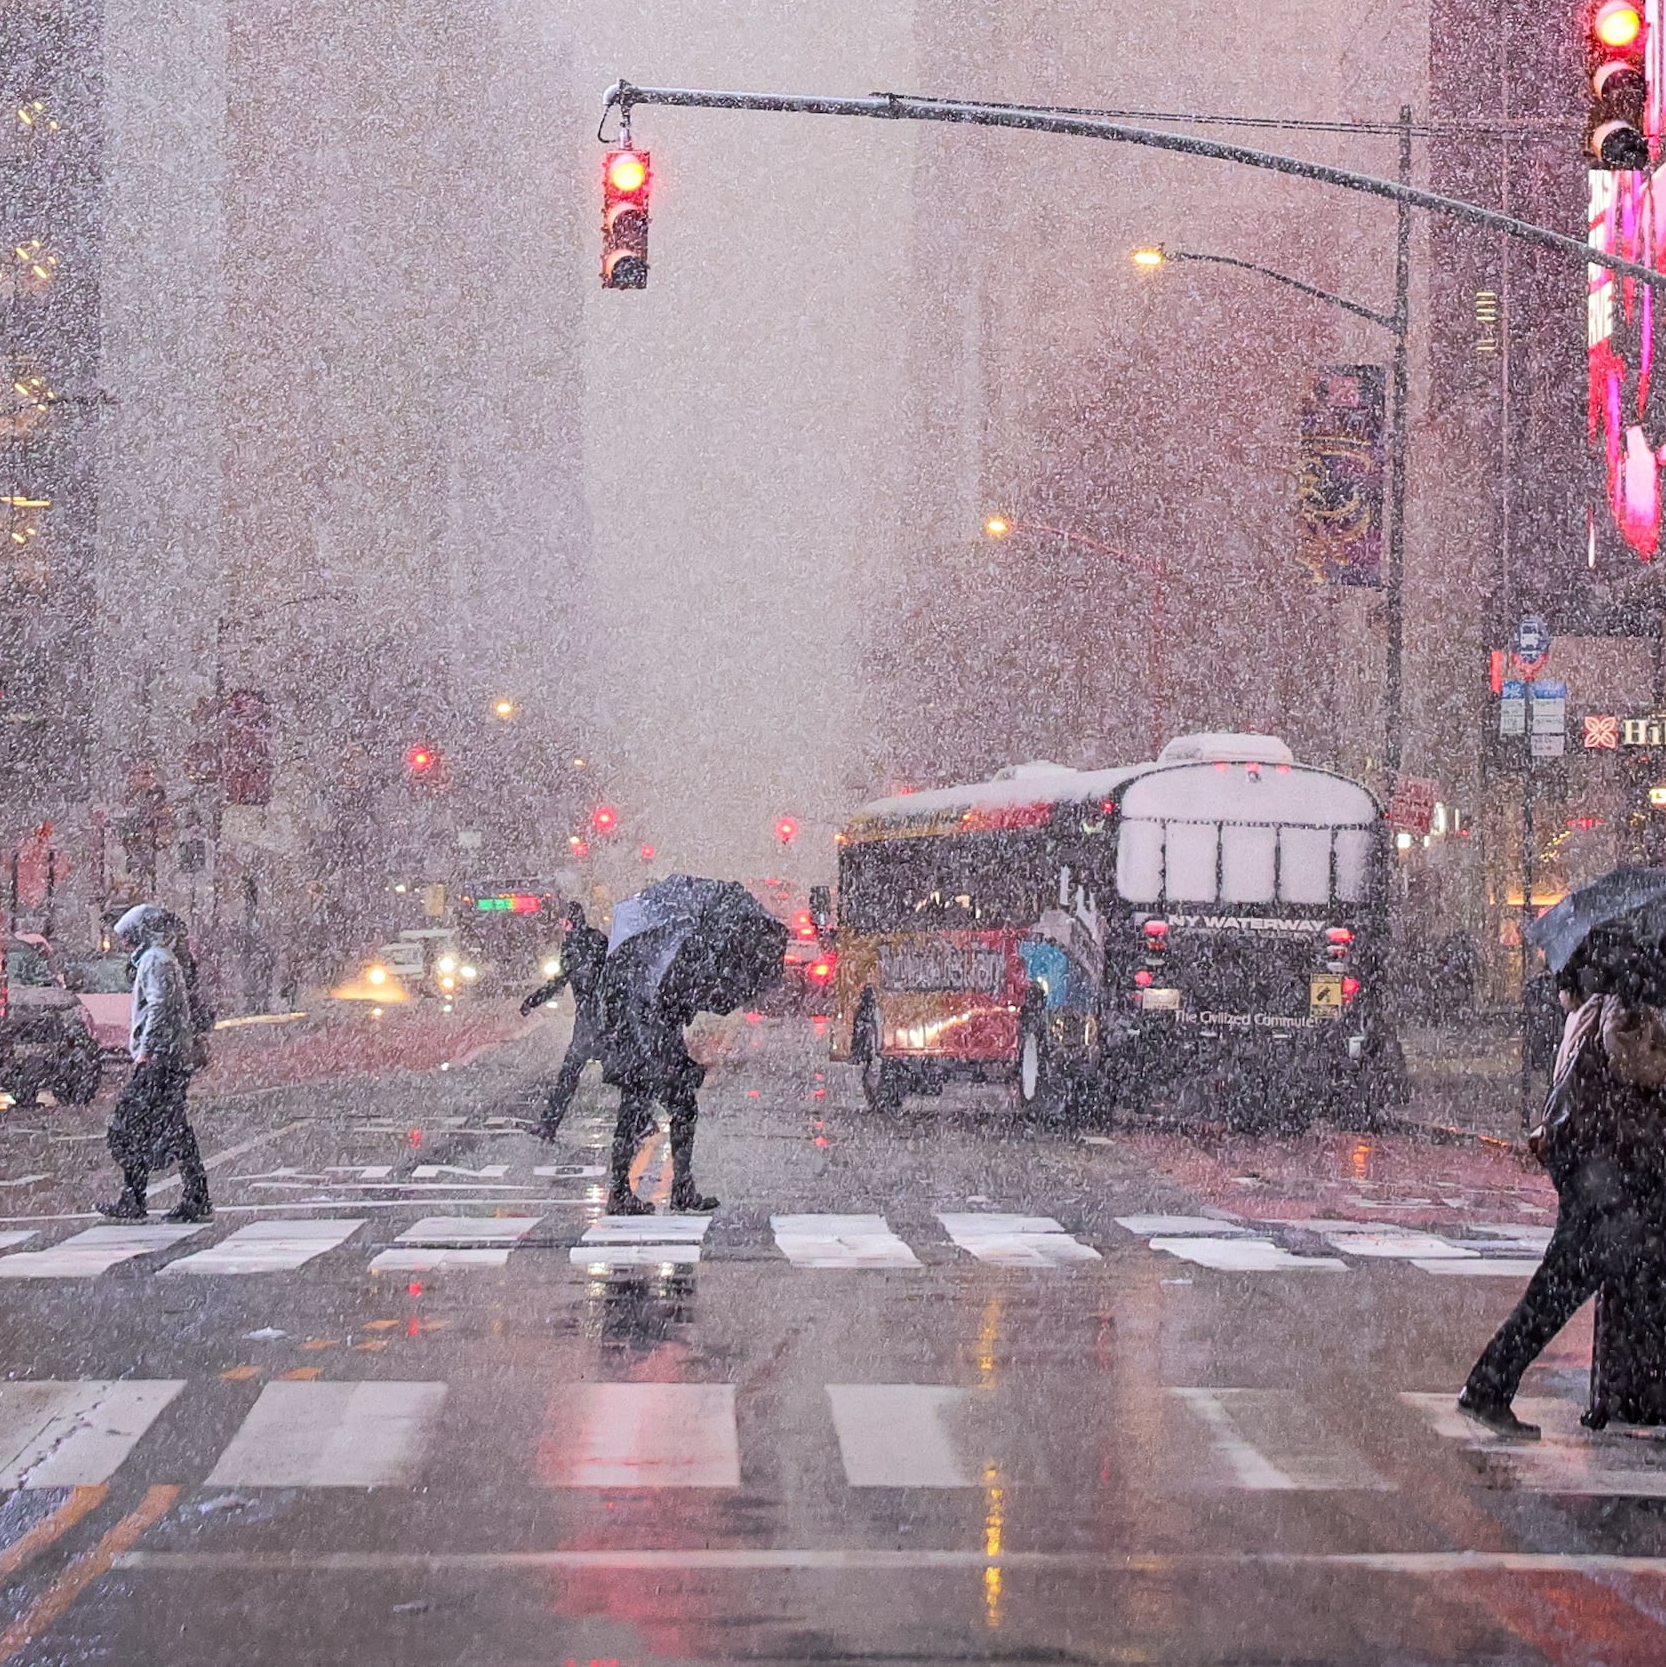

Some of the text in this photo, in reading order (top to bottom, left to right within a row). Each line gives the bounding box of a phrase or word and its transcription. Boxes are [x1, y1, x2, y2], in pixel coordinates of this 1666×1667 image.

[1169, 915, 1327, 933] NY WATERWAY
[1175, 1009, 1198, 1024] The
[1199, 1011, 1252, 1031] Civilized
